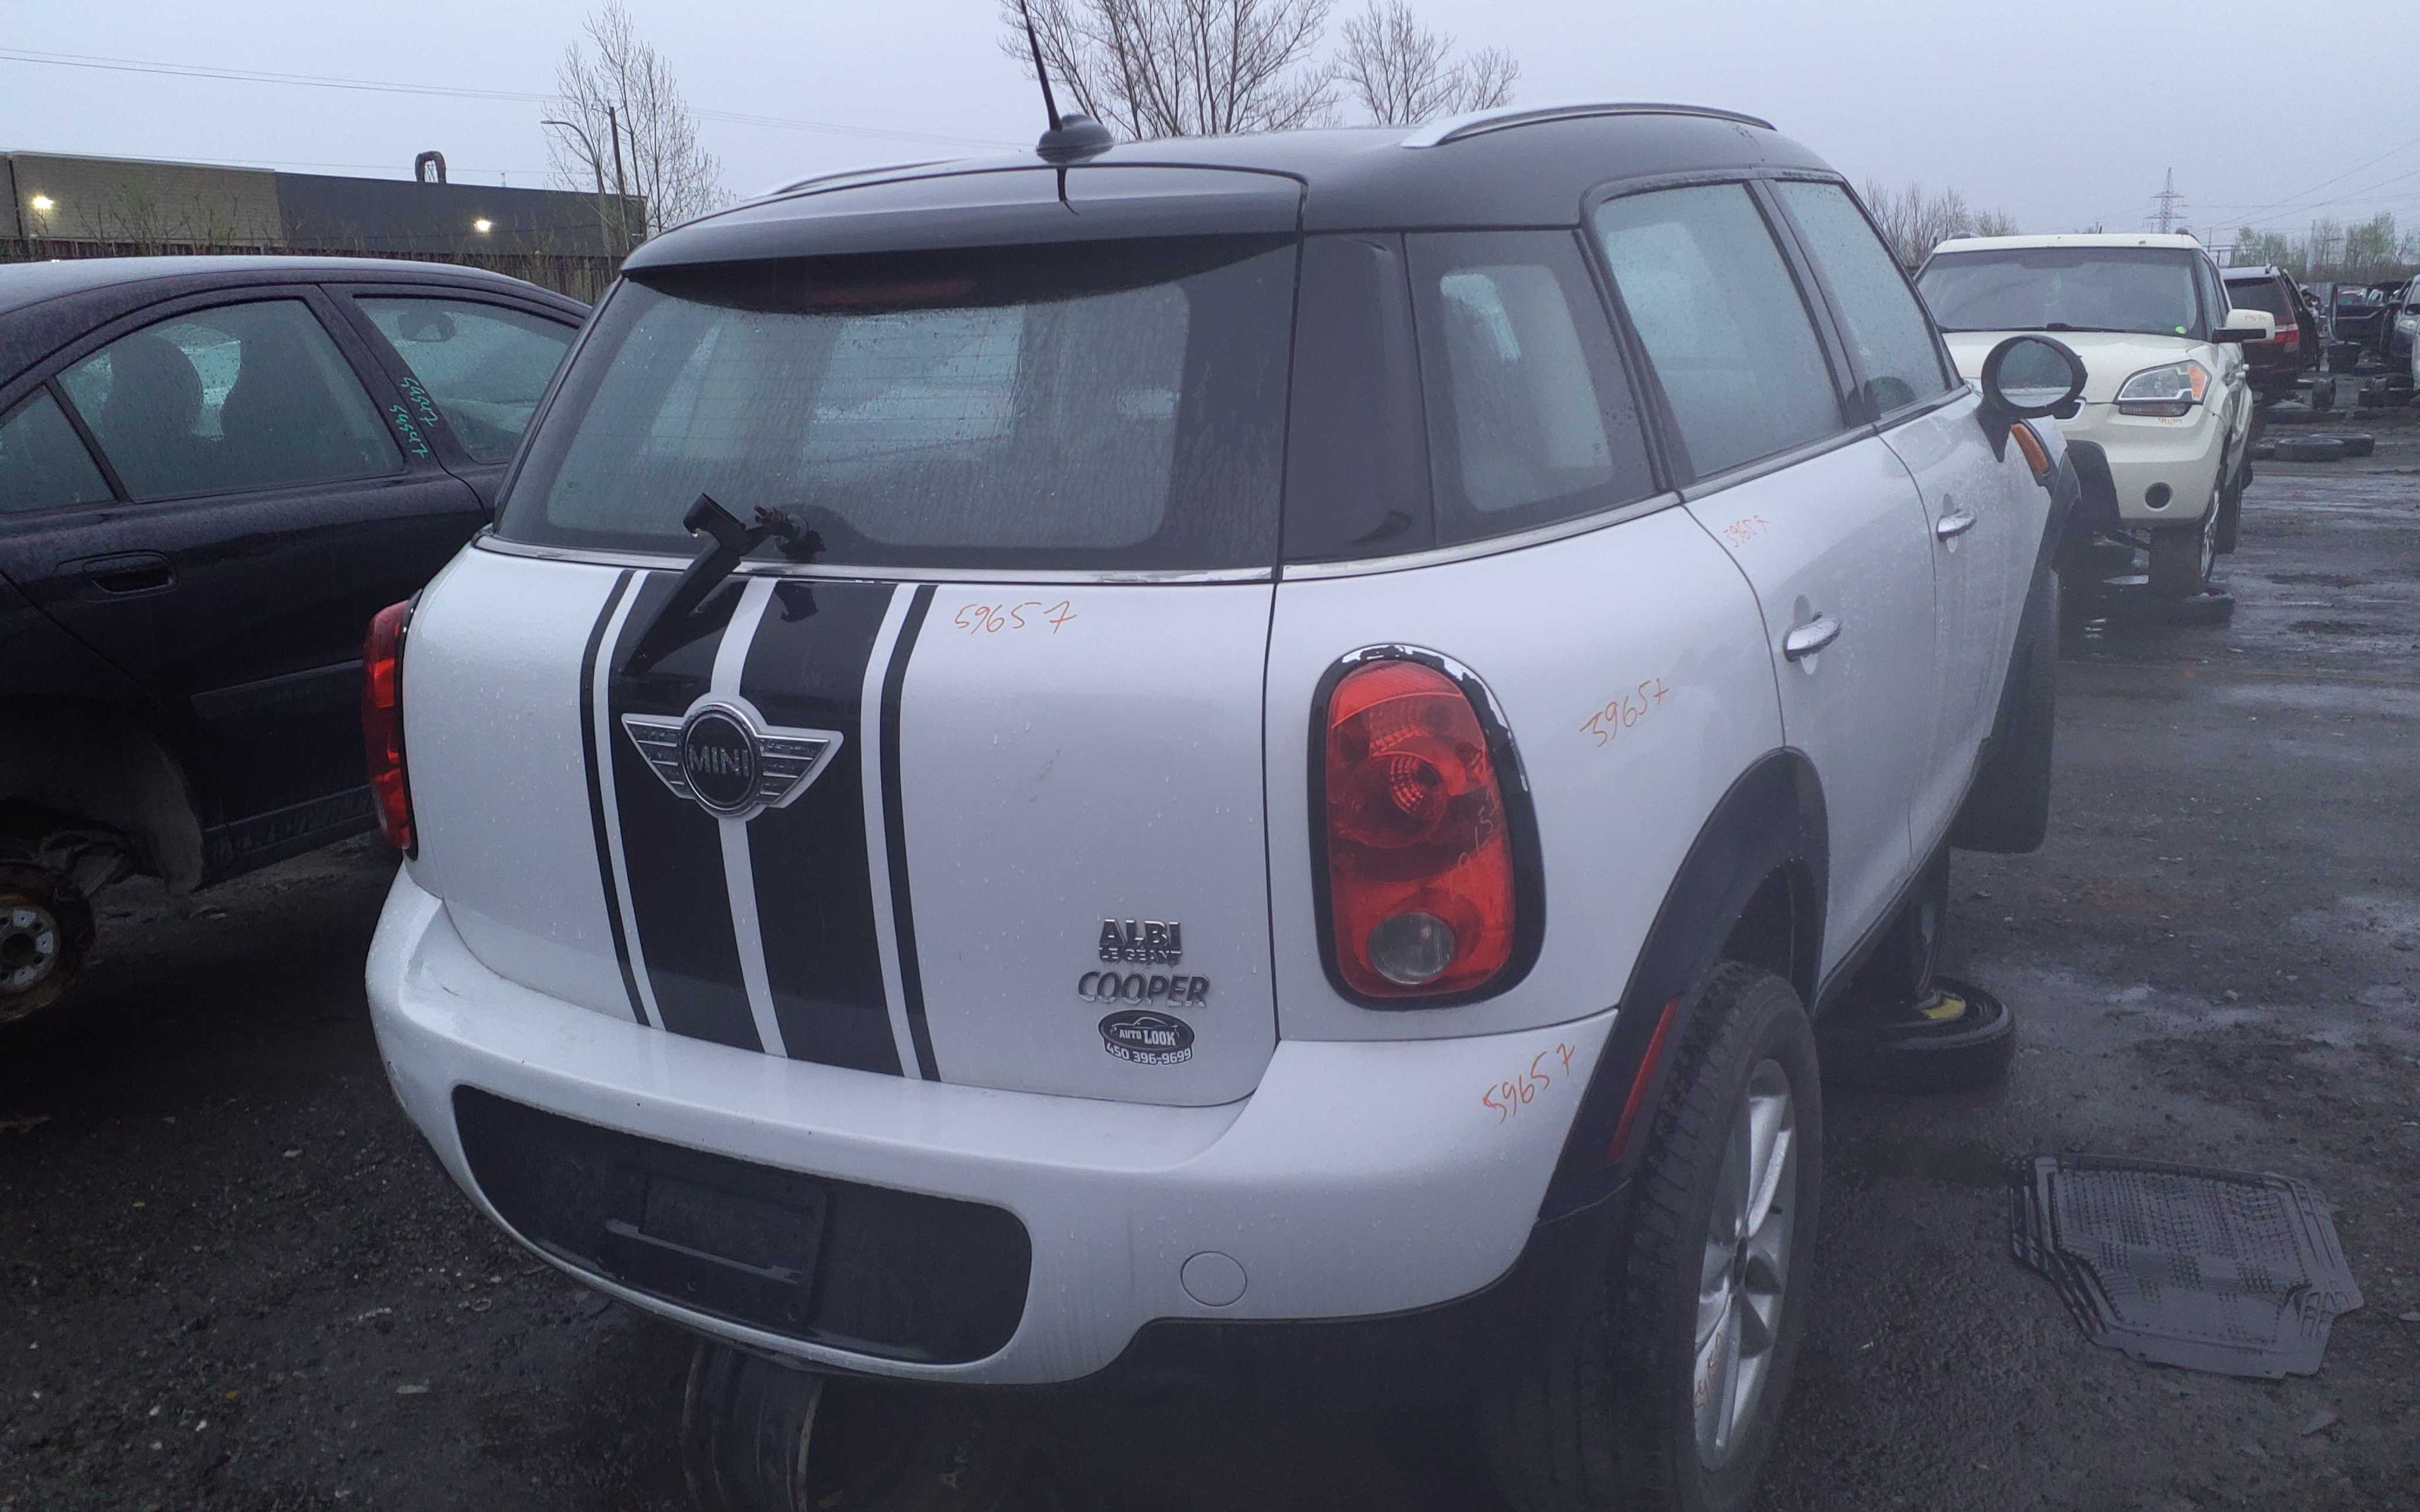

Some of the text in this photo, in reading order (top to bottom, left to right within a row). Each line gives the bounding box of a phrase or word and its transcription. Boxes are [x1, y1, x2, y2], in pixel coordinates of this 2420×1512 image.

[954, 600, 1078, 634] 59657
[688, 744, 749, 777] MINI
[1099, 919, 1181, 947] ALBI
[1078, 970, 1210, 1007] COOPER
[1106, 1043, 1192, 1065] 450 396-9699
[1119, 1029, 1176, 1046] AUTO LOOK
[1482, 1043, 1575, 1125] 59657
